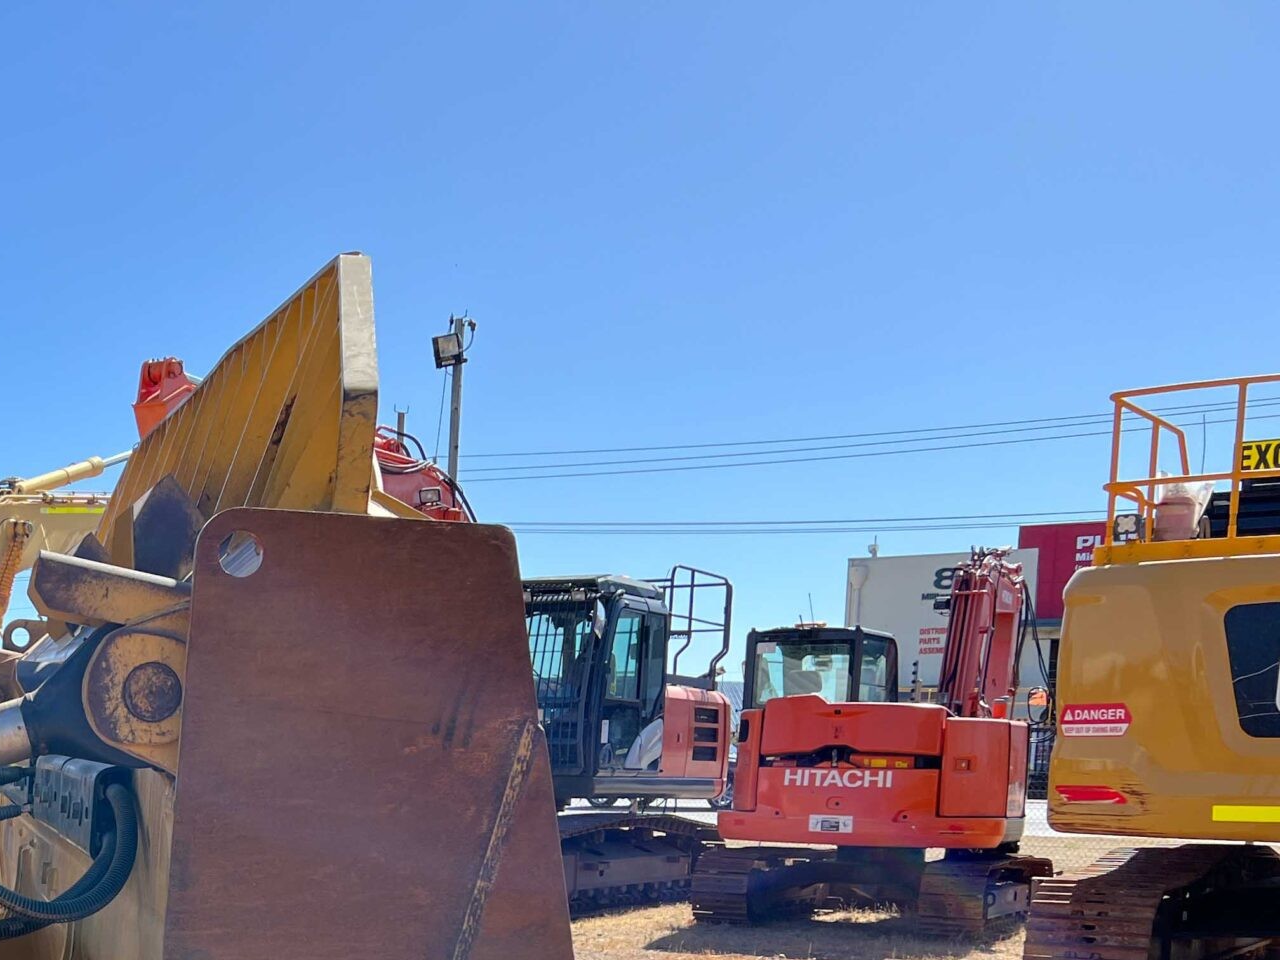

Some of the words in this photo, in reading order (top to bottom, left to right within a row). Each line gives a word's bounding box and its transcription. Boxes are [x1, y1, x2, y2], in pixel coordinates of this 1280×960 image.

[919, 637, 940, 645] PARTS
[1074, 708, 1125, 721] DANGER
[783, 768, 893, 788] HITACHI
